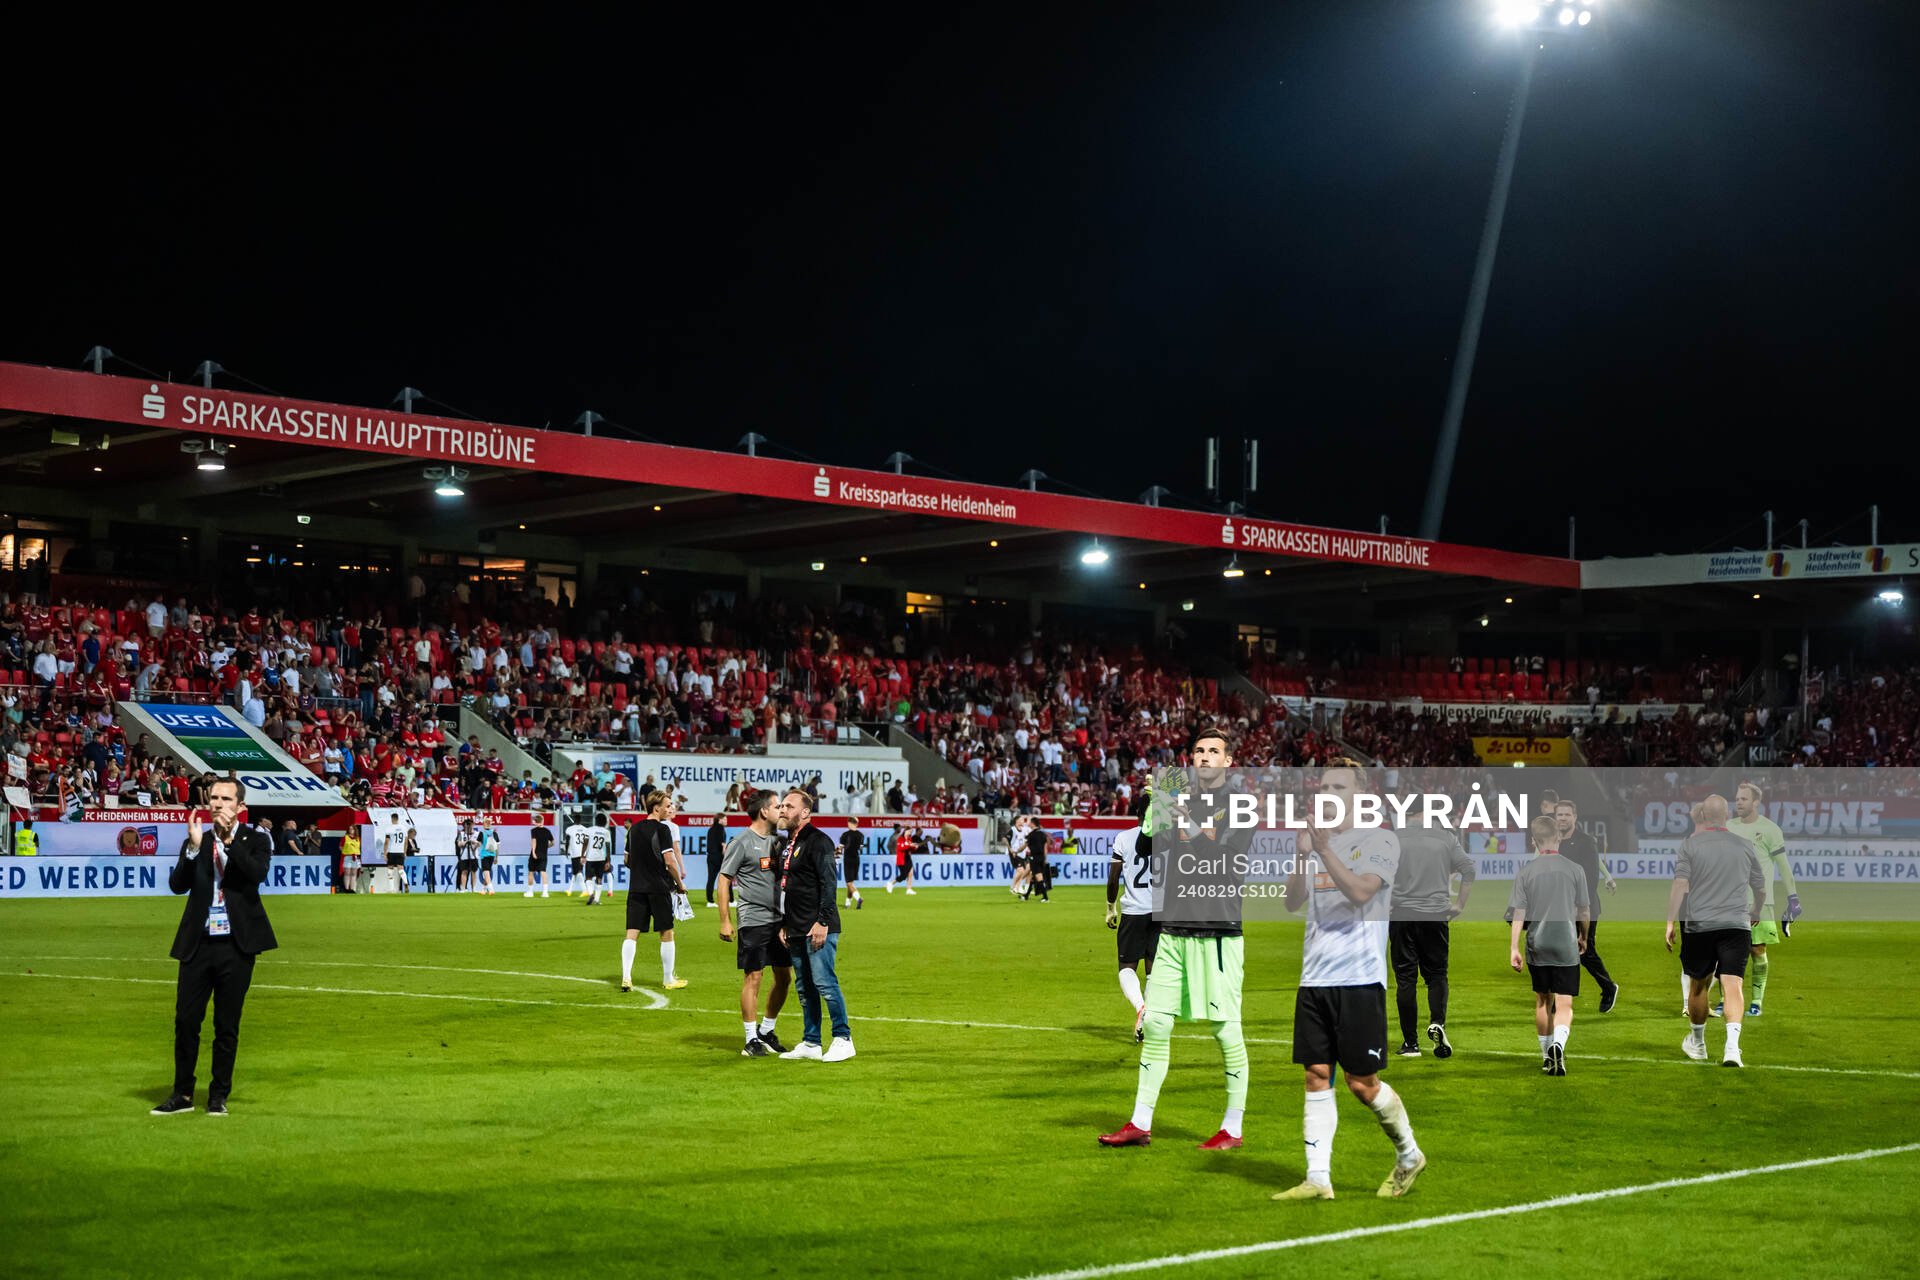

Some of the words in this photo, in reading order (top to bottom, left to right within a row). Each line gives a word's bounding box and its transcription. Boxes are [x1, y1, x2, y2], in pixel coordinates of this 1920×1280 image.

[181, 395, 347, 441] SPARKASSEN
[356, 416, 536, 463] HAUPTTRIBÜNE
[839, 481, 938, 509] Kreissparkasse
[940, 495, 1016, 519] Heidenheim
[1241, 525, 1329, 555] SPARKASSEN
[1331, 536, 1430, 566] HAUPTTRIBÜNE
[1710, 555, 1763, 566] Stadtwerke
[1807, 550, 1863, 562] Stadtwerke
[1707, 566, 1762, 576] Heidenheim
[1805, 562, 1861, 572] Heidenheim
[154, 713, 234, 728] UEFA
[1506, 742, 1552, 754] LOTTO
[217, 751, 265, 760] RESPECT
[661, 766, 738, 782] EXZELLENTE
[240, 776, 328, 791] OITH
[97, 812, 149, 821] HEIDENHEIM
[151, 812, 169, 821] 1846
[394, 832, 404, 844] 19
[593, 836, 605, 850] 23
[940, 862, 994, 880] UNTER
[1481, 860, 1514, 875] MEHR
[39, 866, 155, 889] WERDEN
